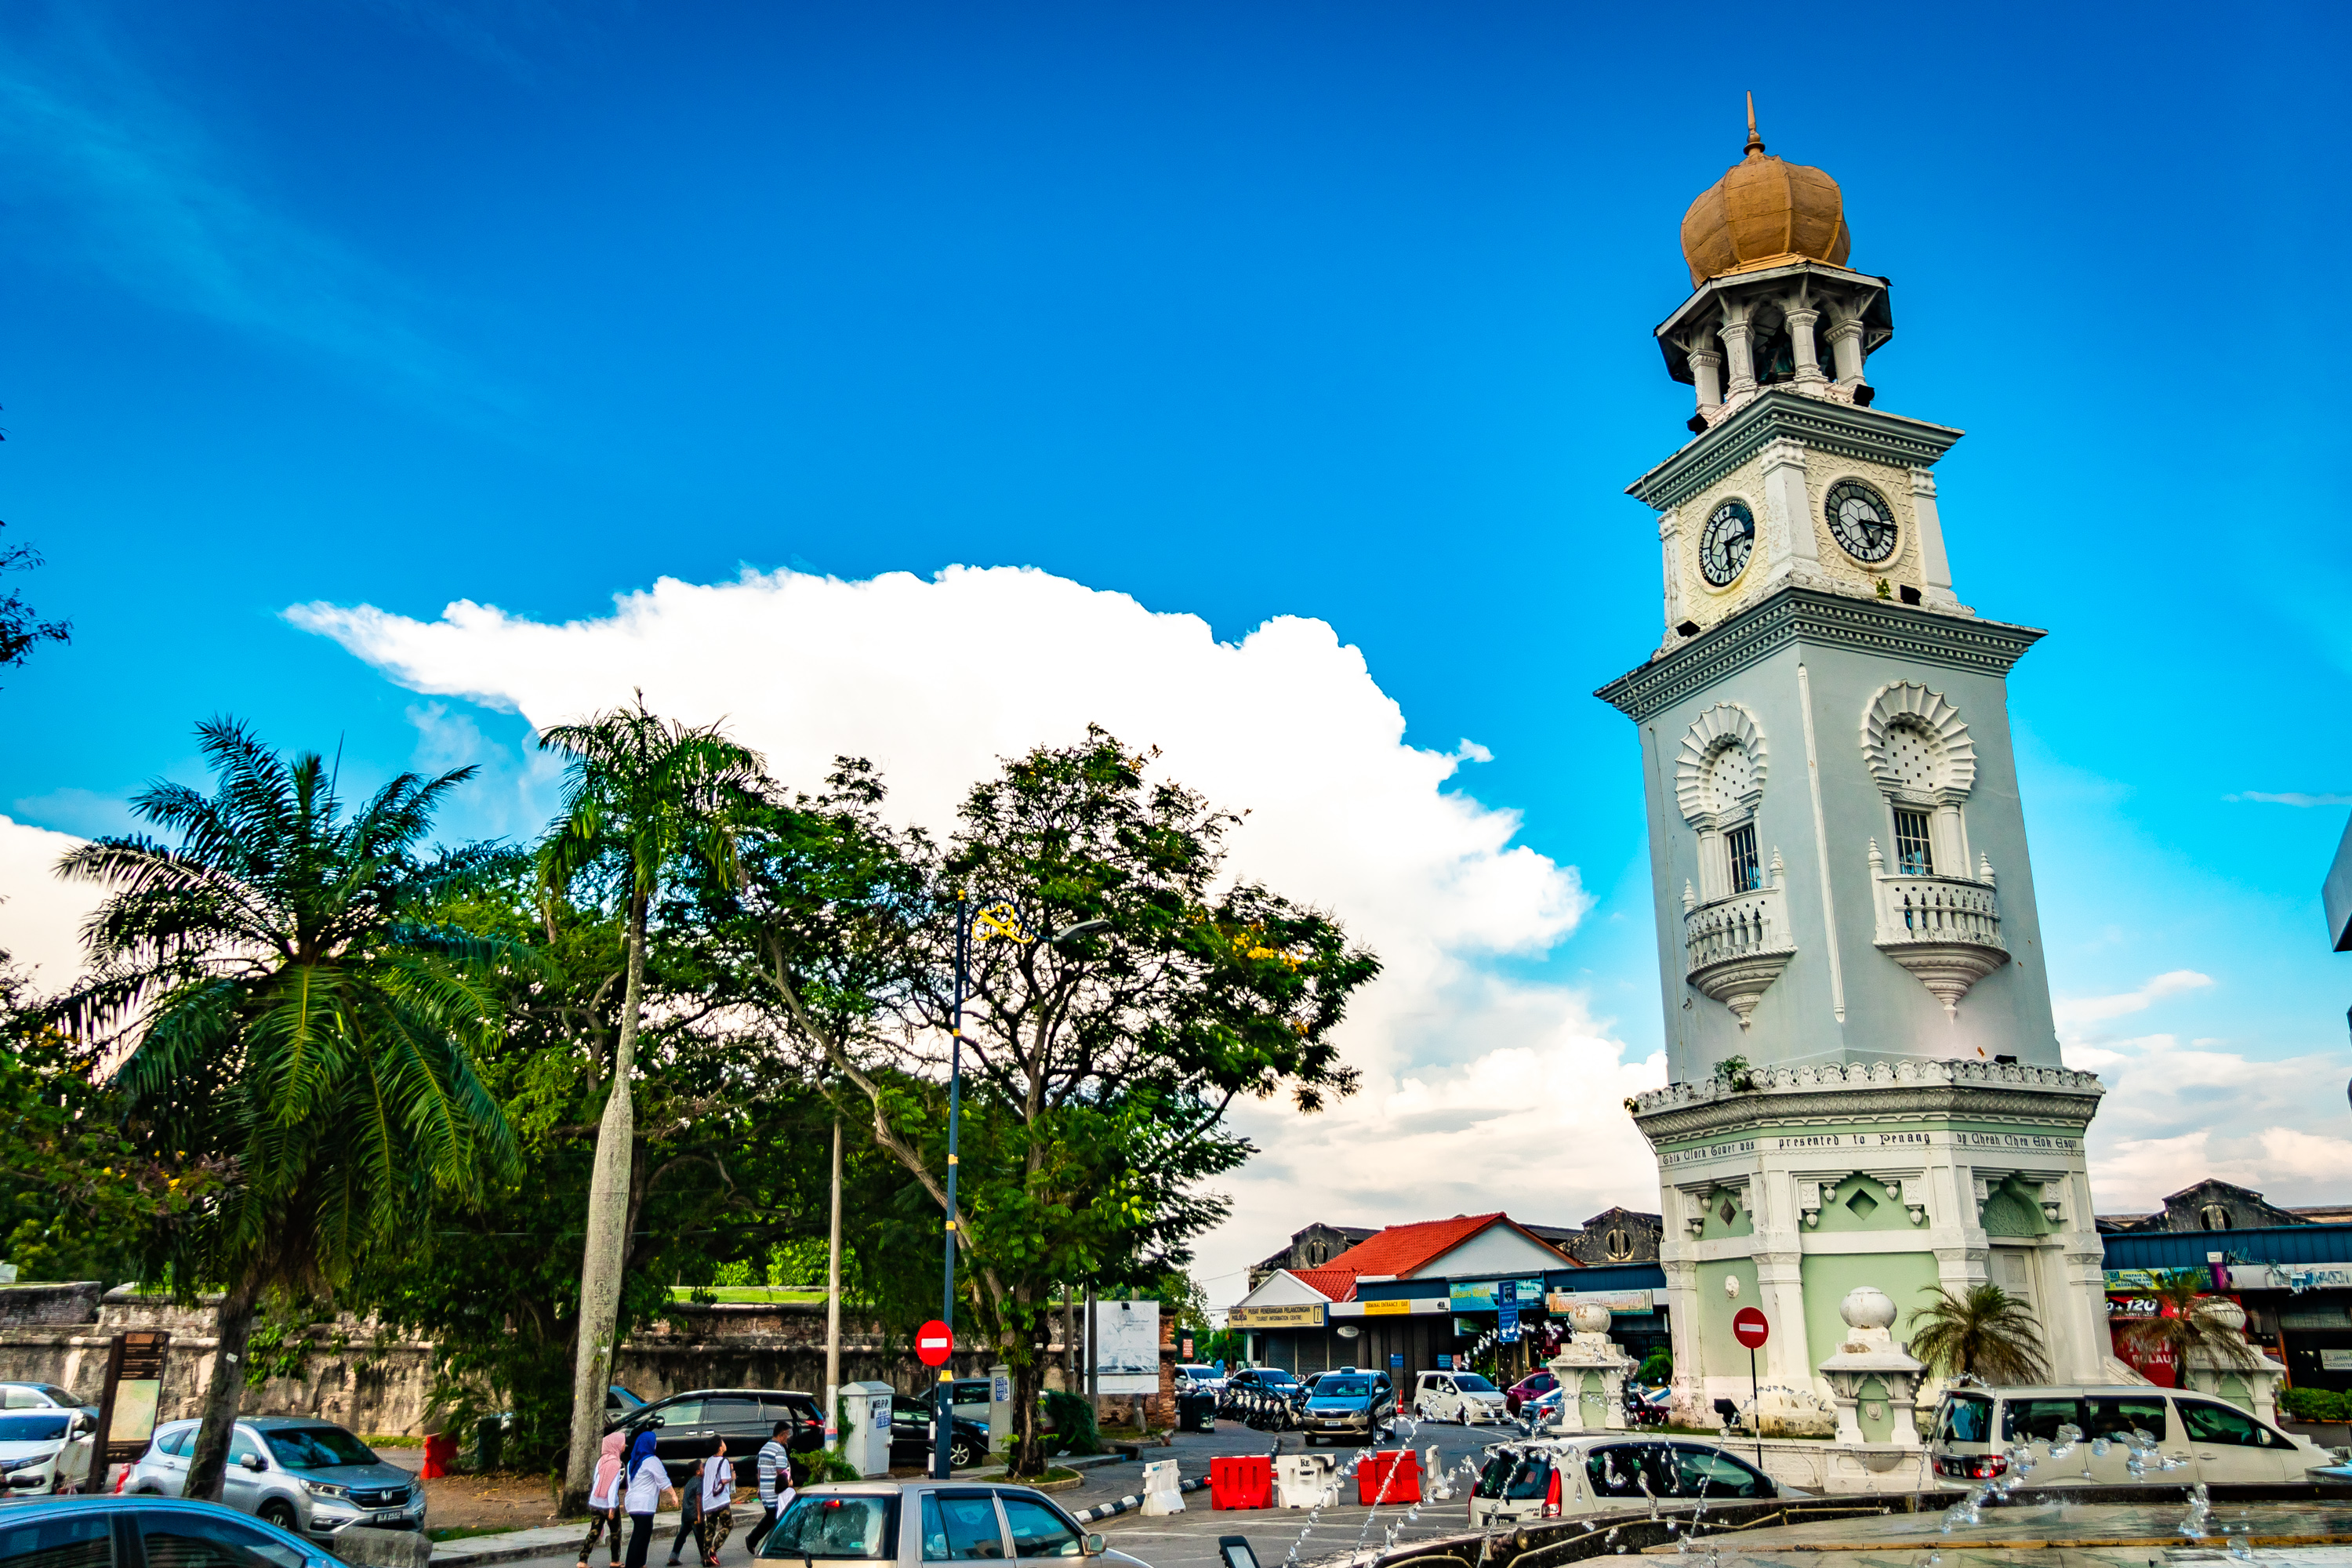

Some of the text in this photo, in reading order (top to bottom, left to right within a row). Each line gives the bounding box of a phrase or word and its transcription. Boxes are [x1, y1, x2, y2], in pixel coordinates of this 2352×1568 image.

[1662, 1152, 1679, 1164] This
[1683, 1148, 1706, 1160] Clock
[1711, 1144, 1735, 1156] Tower
[1740, 1141, 1755, 1151] was
[1779, 1134, 1839, 1149] presented
[1853, 1134, 1865, 1145] to
[1879, 1132, 1931, 1145] Penang
[1957, 1133, 1967, 1145] by
[1972, 1133, 2000, 1147] Cheah
[1450, 1287, 1490, 1298] Leisure World
[2126, 1298, 2158, 1312] 120
[873, 1399, 889, 1409] MBPP
